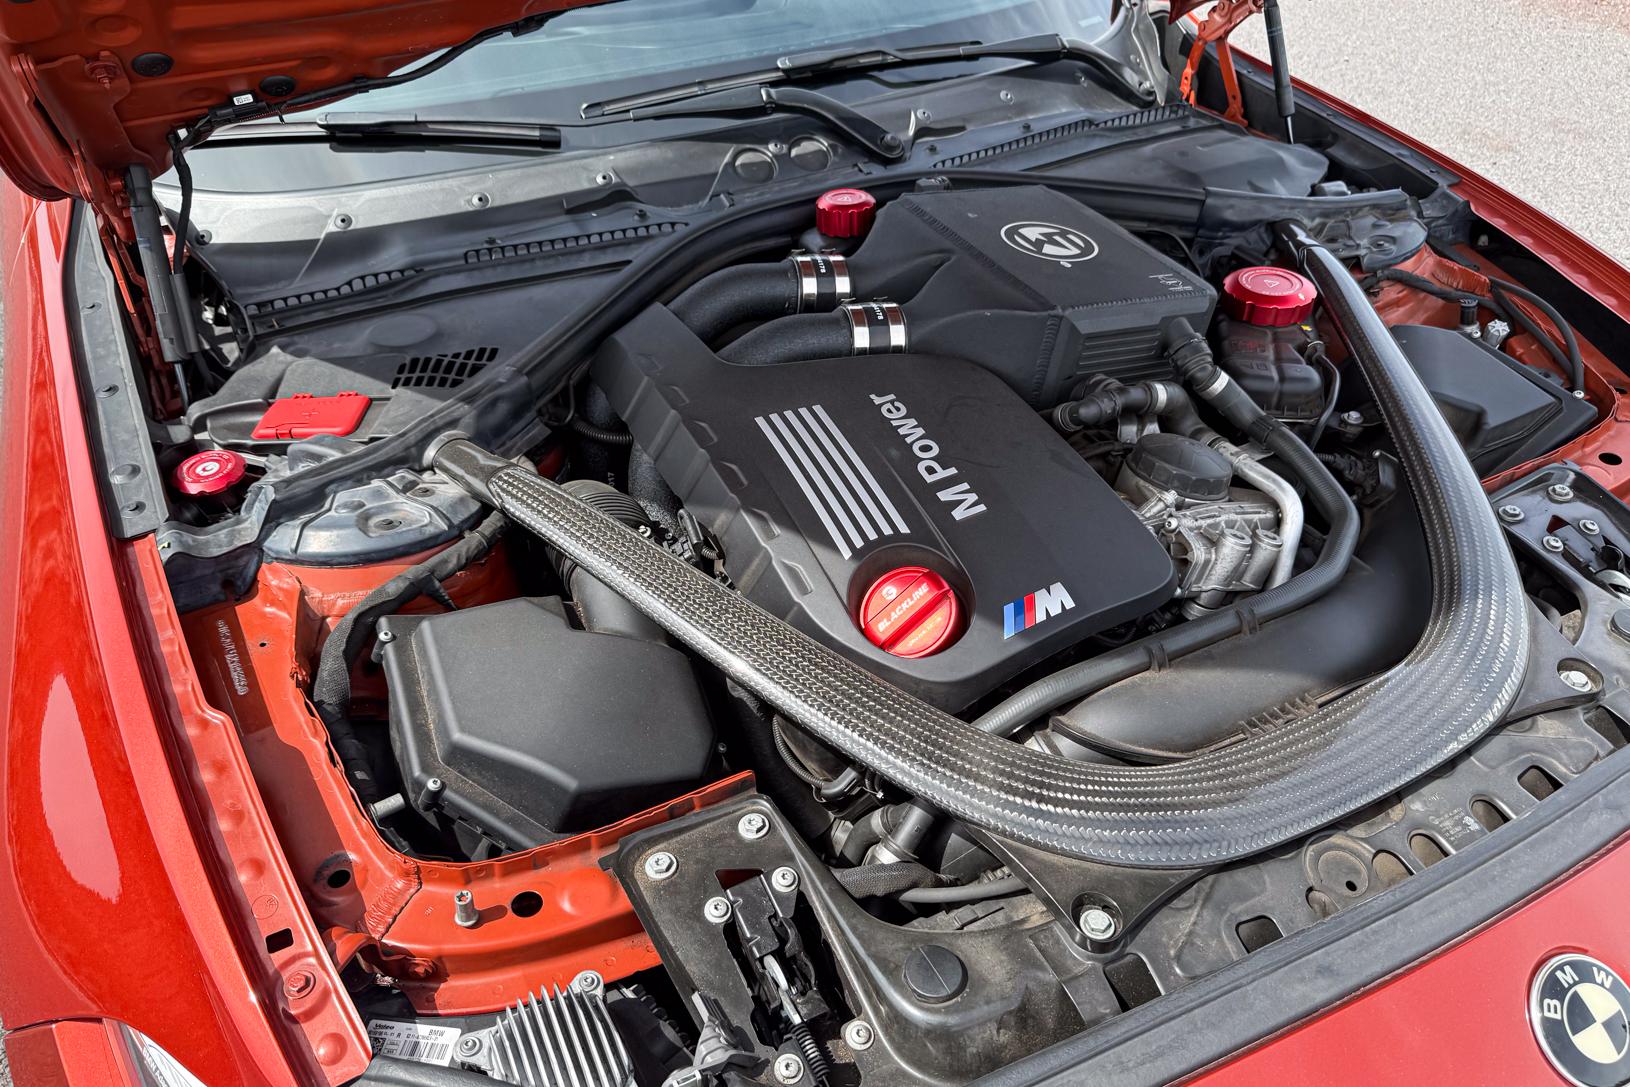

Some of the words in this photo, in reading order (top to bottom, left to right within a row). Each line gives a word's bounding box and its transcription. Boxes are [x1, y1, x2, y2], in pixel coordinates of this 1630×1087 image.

[869, 393, 958, 484] Power
[935, 482, 987, 521] M
[878, 582, 929, 632] BLACKLINE
[1543, 965, 1613, 1020] BMW
[428, 1029, 446, 1037] BMW
